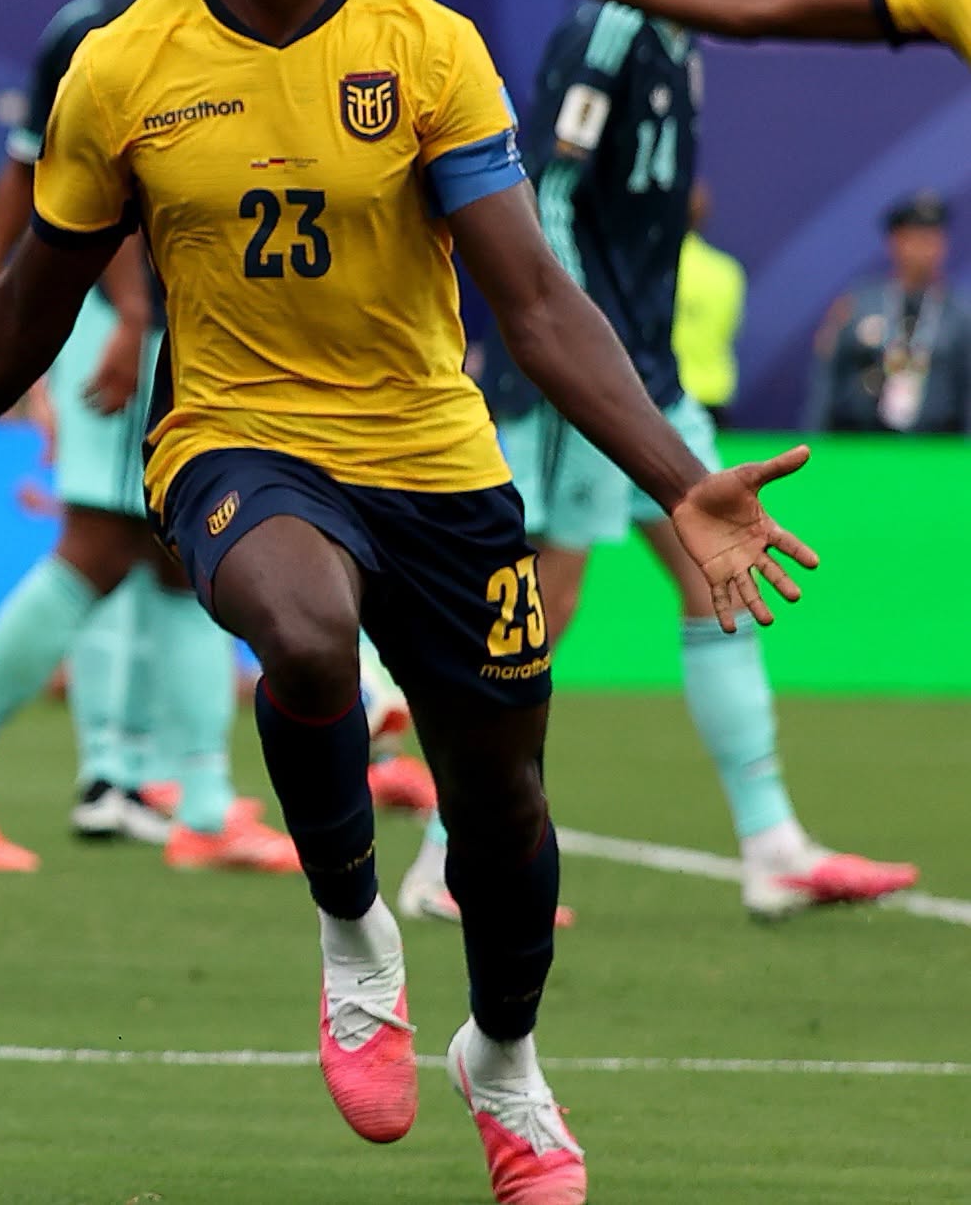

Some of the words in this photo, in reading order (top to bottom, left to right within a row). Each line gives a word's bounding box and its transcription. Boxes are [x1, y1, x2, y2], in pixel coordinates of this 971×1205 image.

[143, 99, 244, 129] marathon
[239, 189, 332, 278] 23
[486, 554, 545, 656] 23
